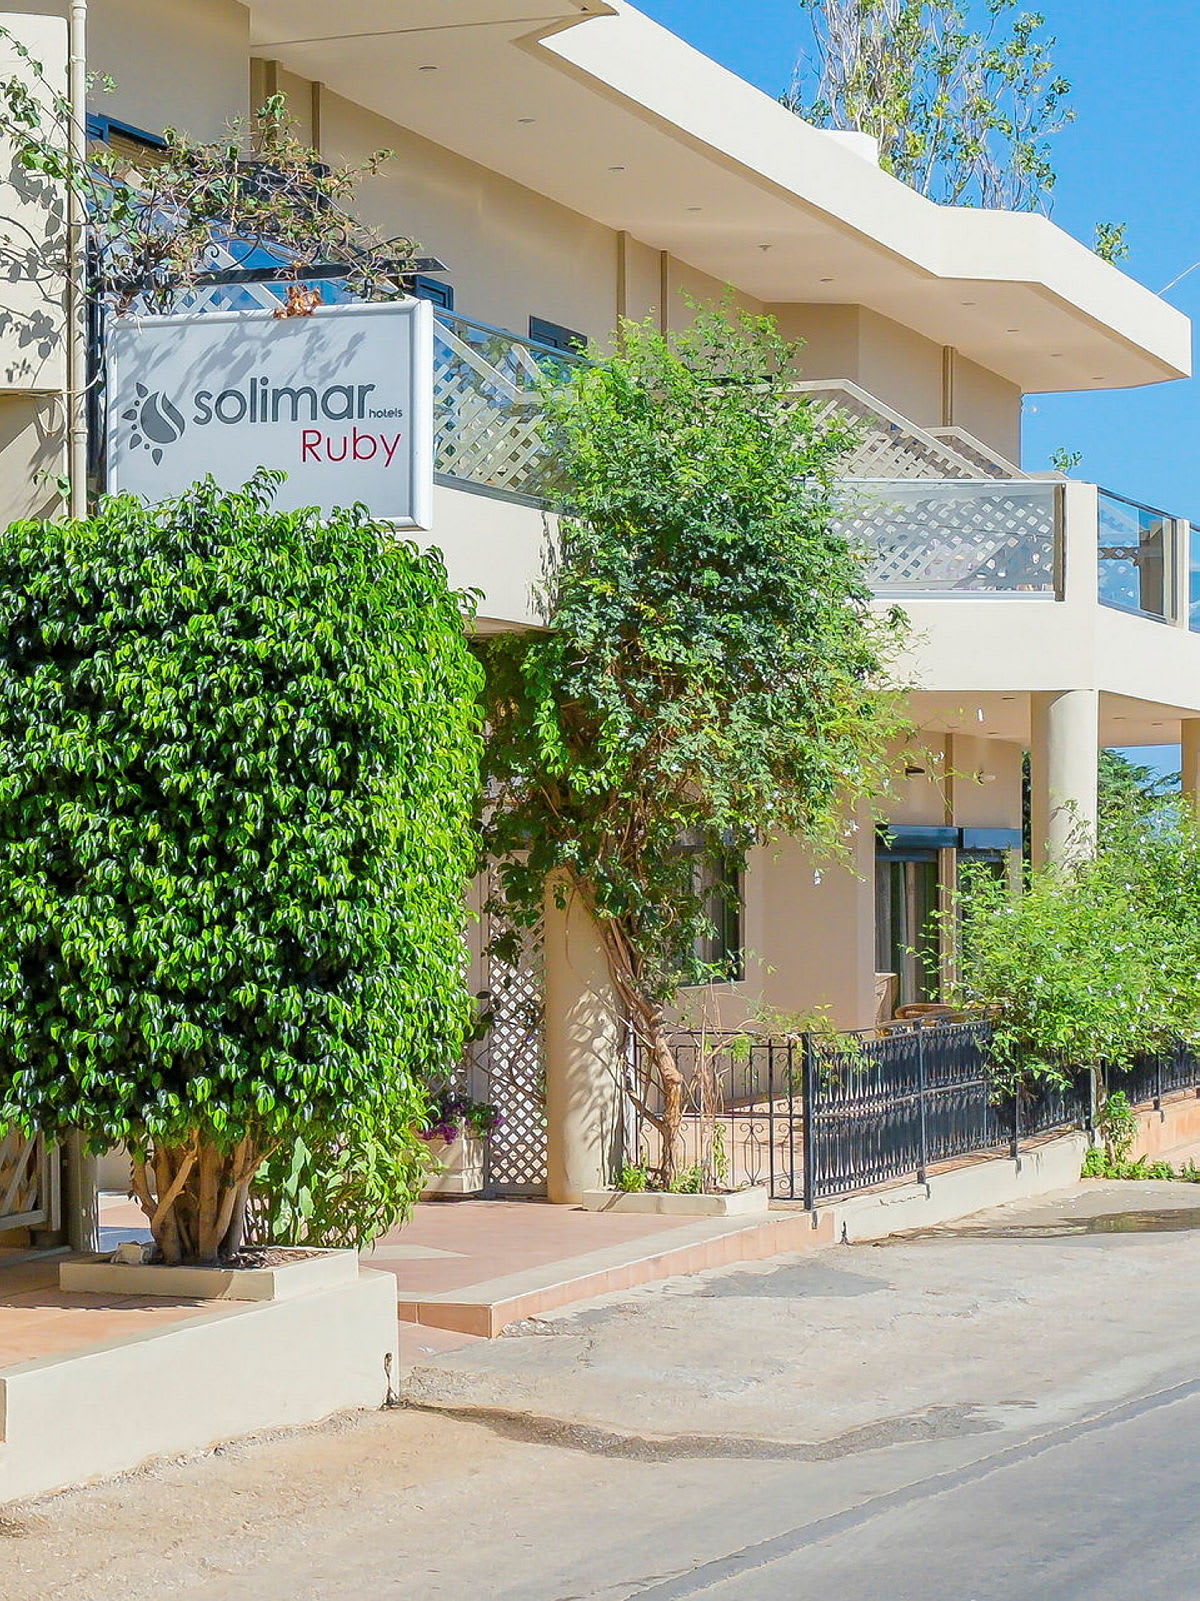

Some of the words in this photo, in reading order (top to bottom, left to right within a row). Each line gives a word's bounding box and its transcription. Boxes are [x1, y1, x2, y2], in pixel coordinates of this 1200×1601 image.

[193, 377, 376, 426] solimar
[368, 408, 403, 419] hotels
[302, 427, 402, 468] Ruby
